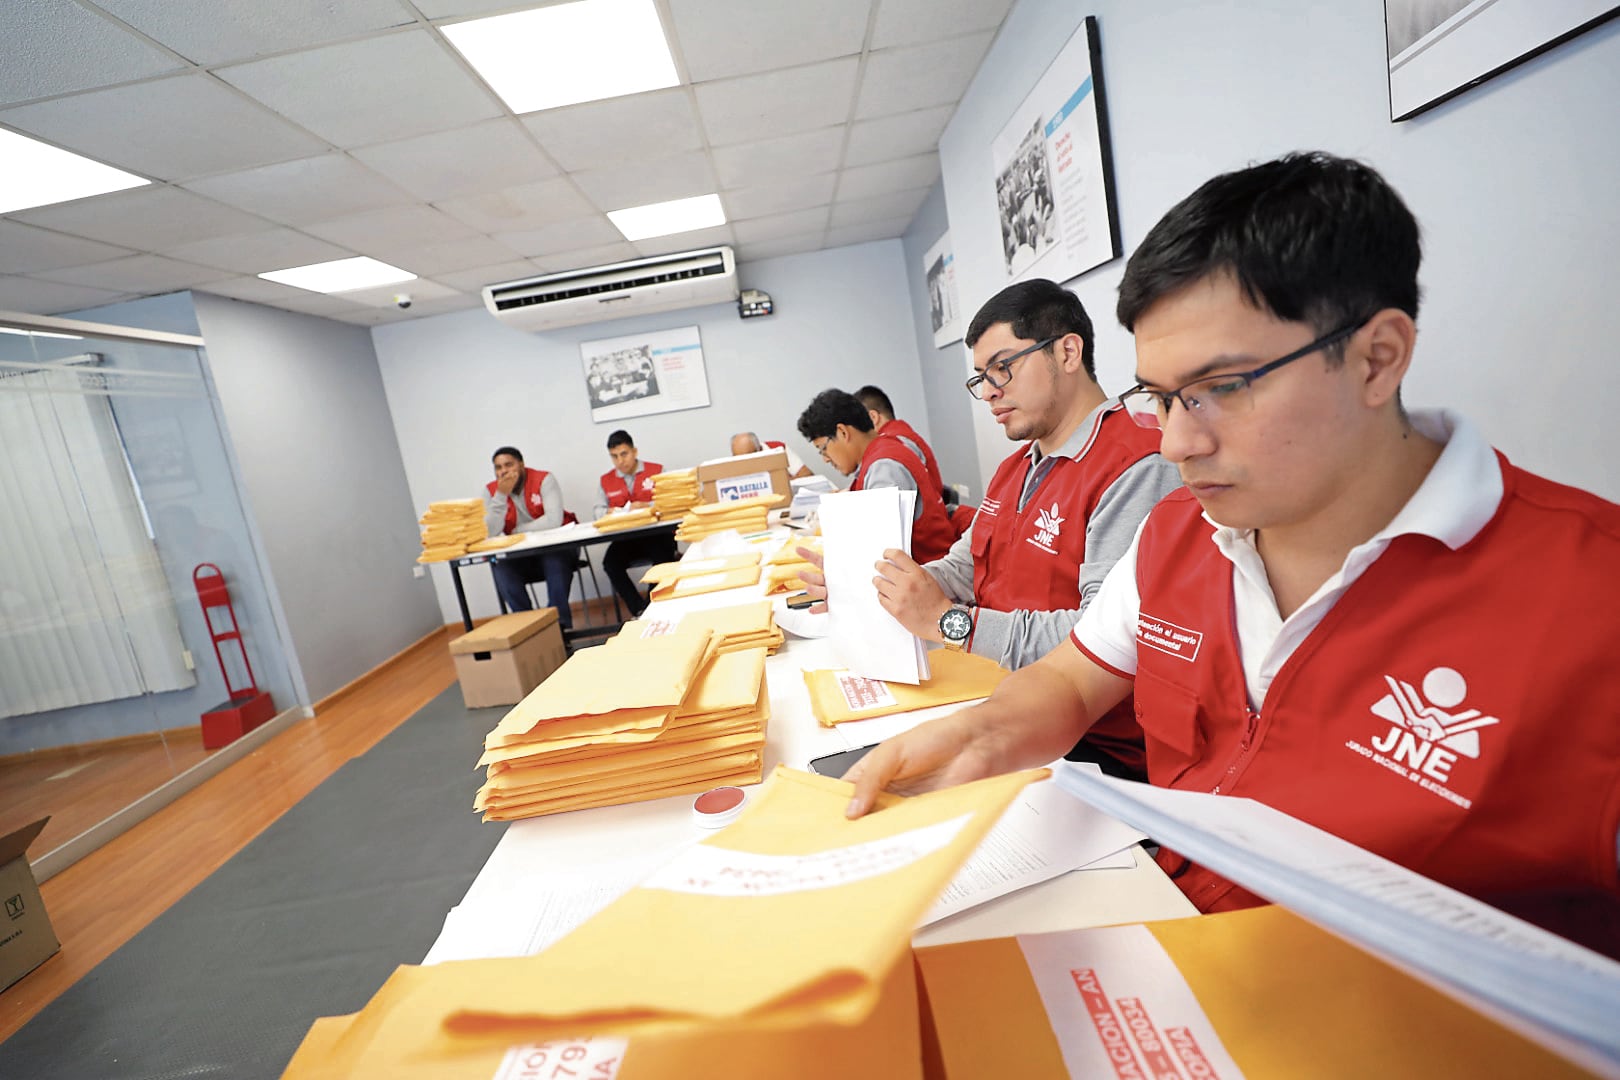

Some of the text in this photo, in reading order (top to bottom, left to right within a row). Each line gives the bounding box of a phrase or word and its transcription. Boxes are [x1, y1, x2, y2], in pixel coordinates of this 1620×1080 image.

[739, 481, 769, 493] BATALLA
[1034, 529, 1055, 548] JNE
[1371, 726, 1458, 783] JNE
[1372, 753, 1409, 778] NACIONAL
[1408, 772, 1421, 783] DE
